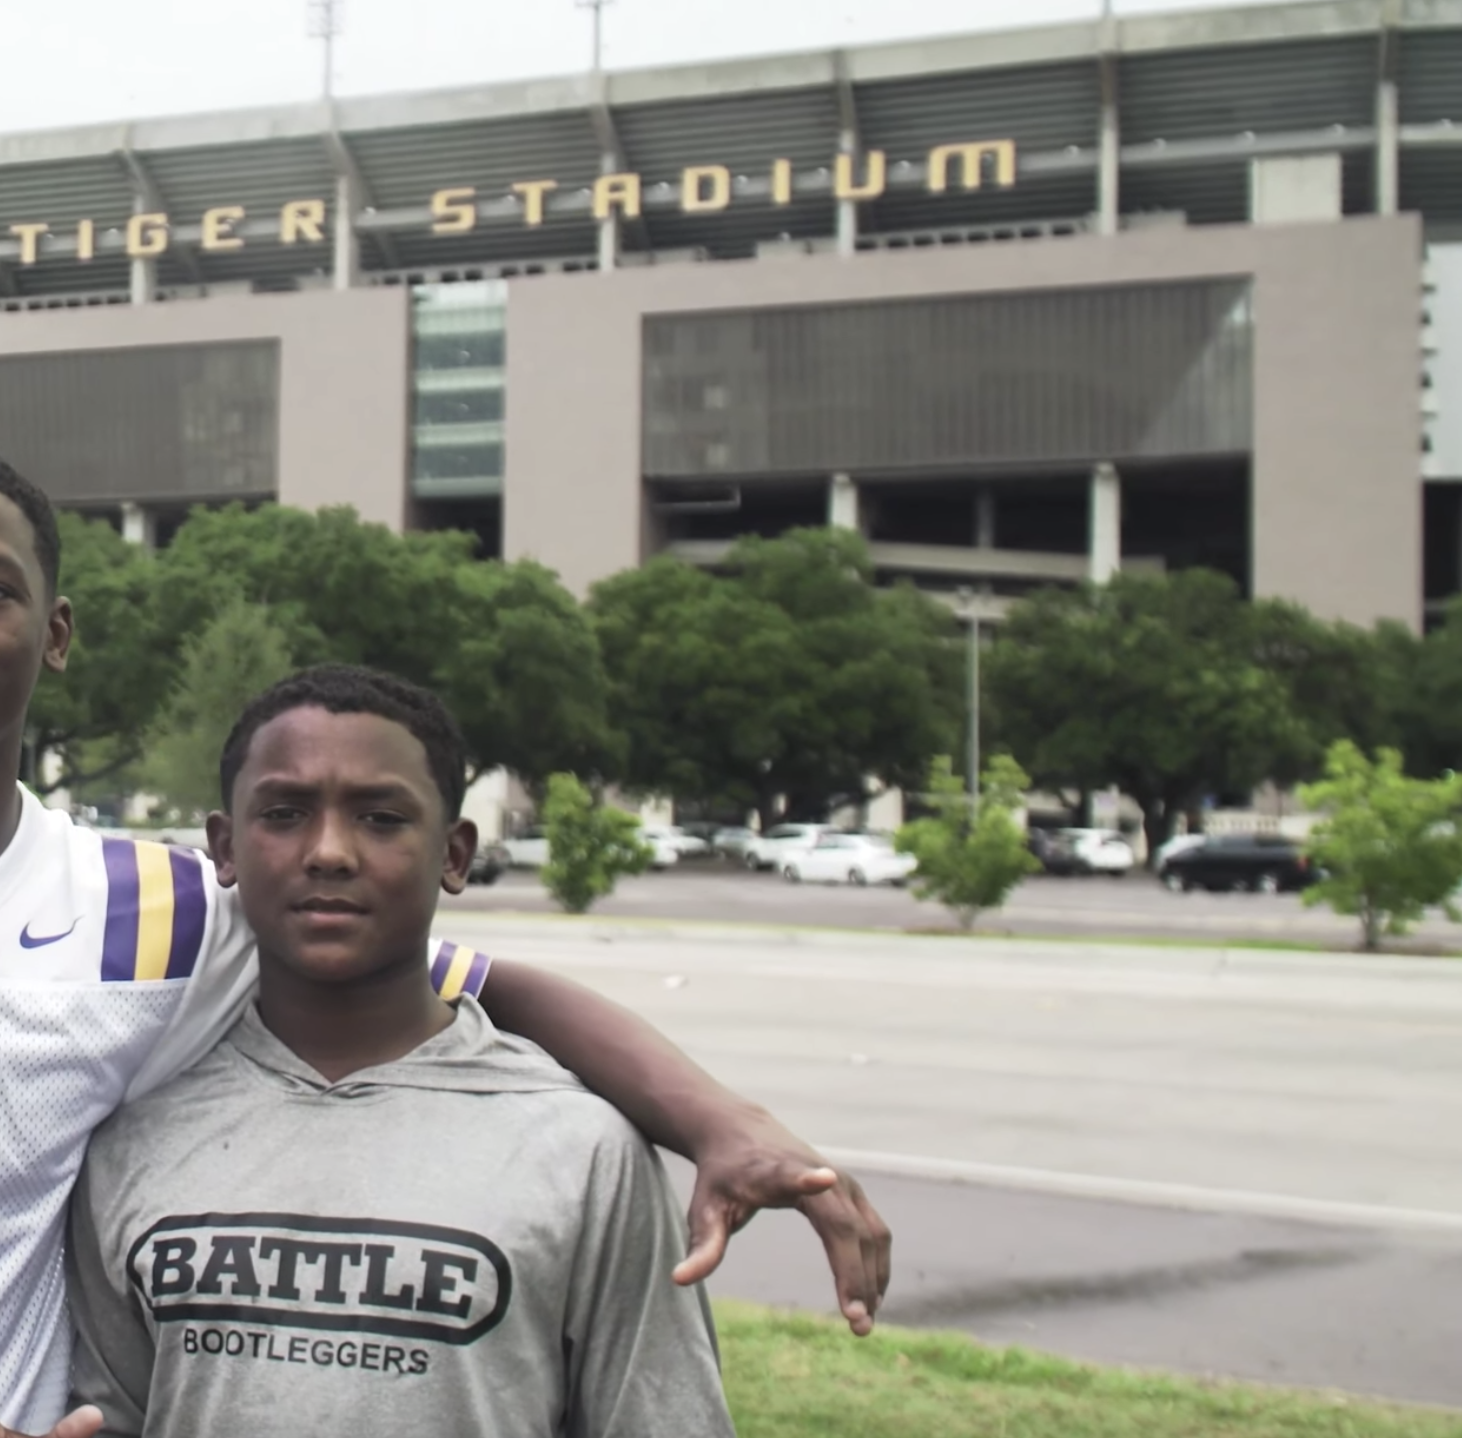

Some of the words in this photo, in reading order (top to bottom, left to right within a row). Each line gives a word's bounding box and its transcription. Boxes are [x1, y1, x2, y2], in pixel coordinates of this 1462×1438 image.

[10, 199, 325, 264] TIGER
[431, 138, 1015, 232] STADIUM
[151, 1235, 478, 1319] BATTLE
[183, 1328, 430, 1375] BOOTLEGGERS
